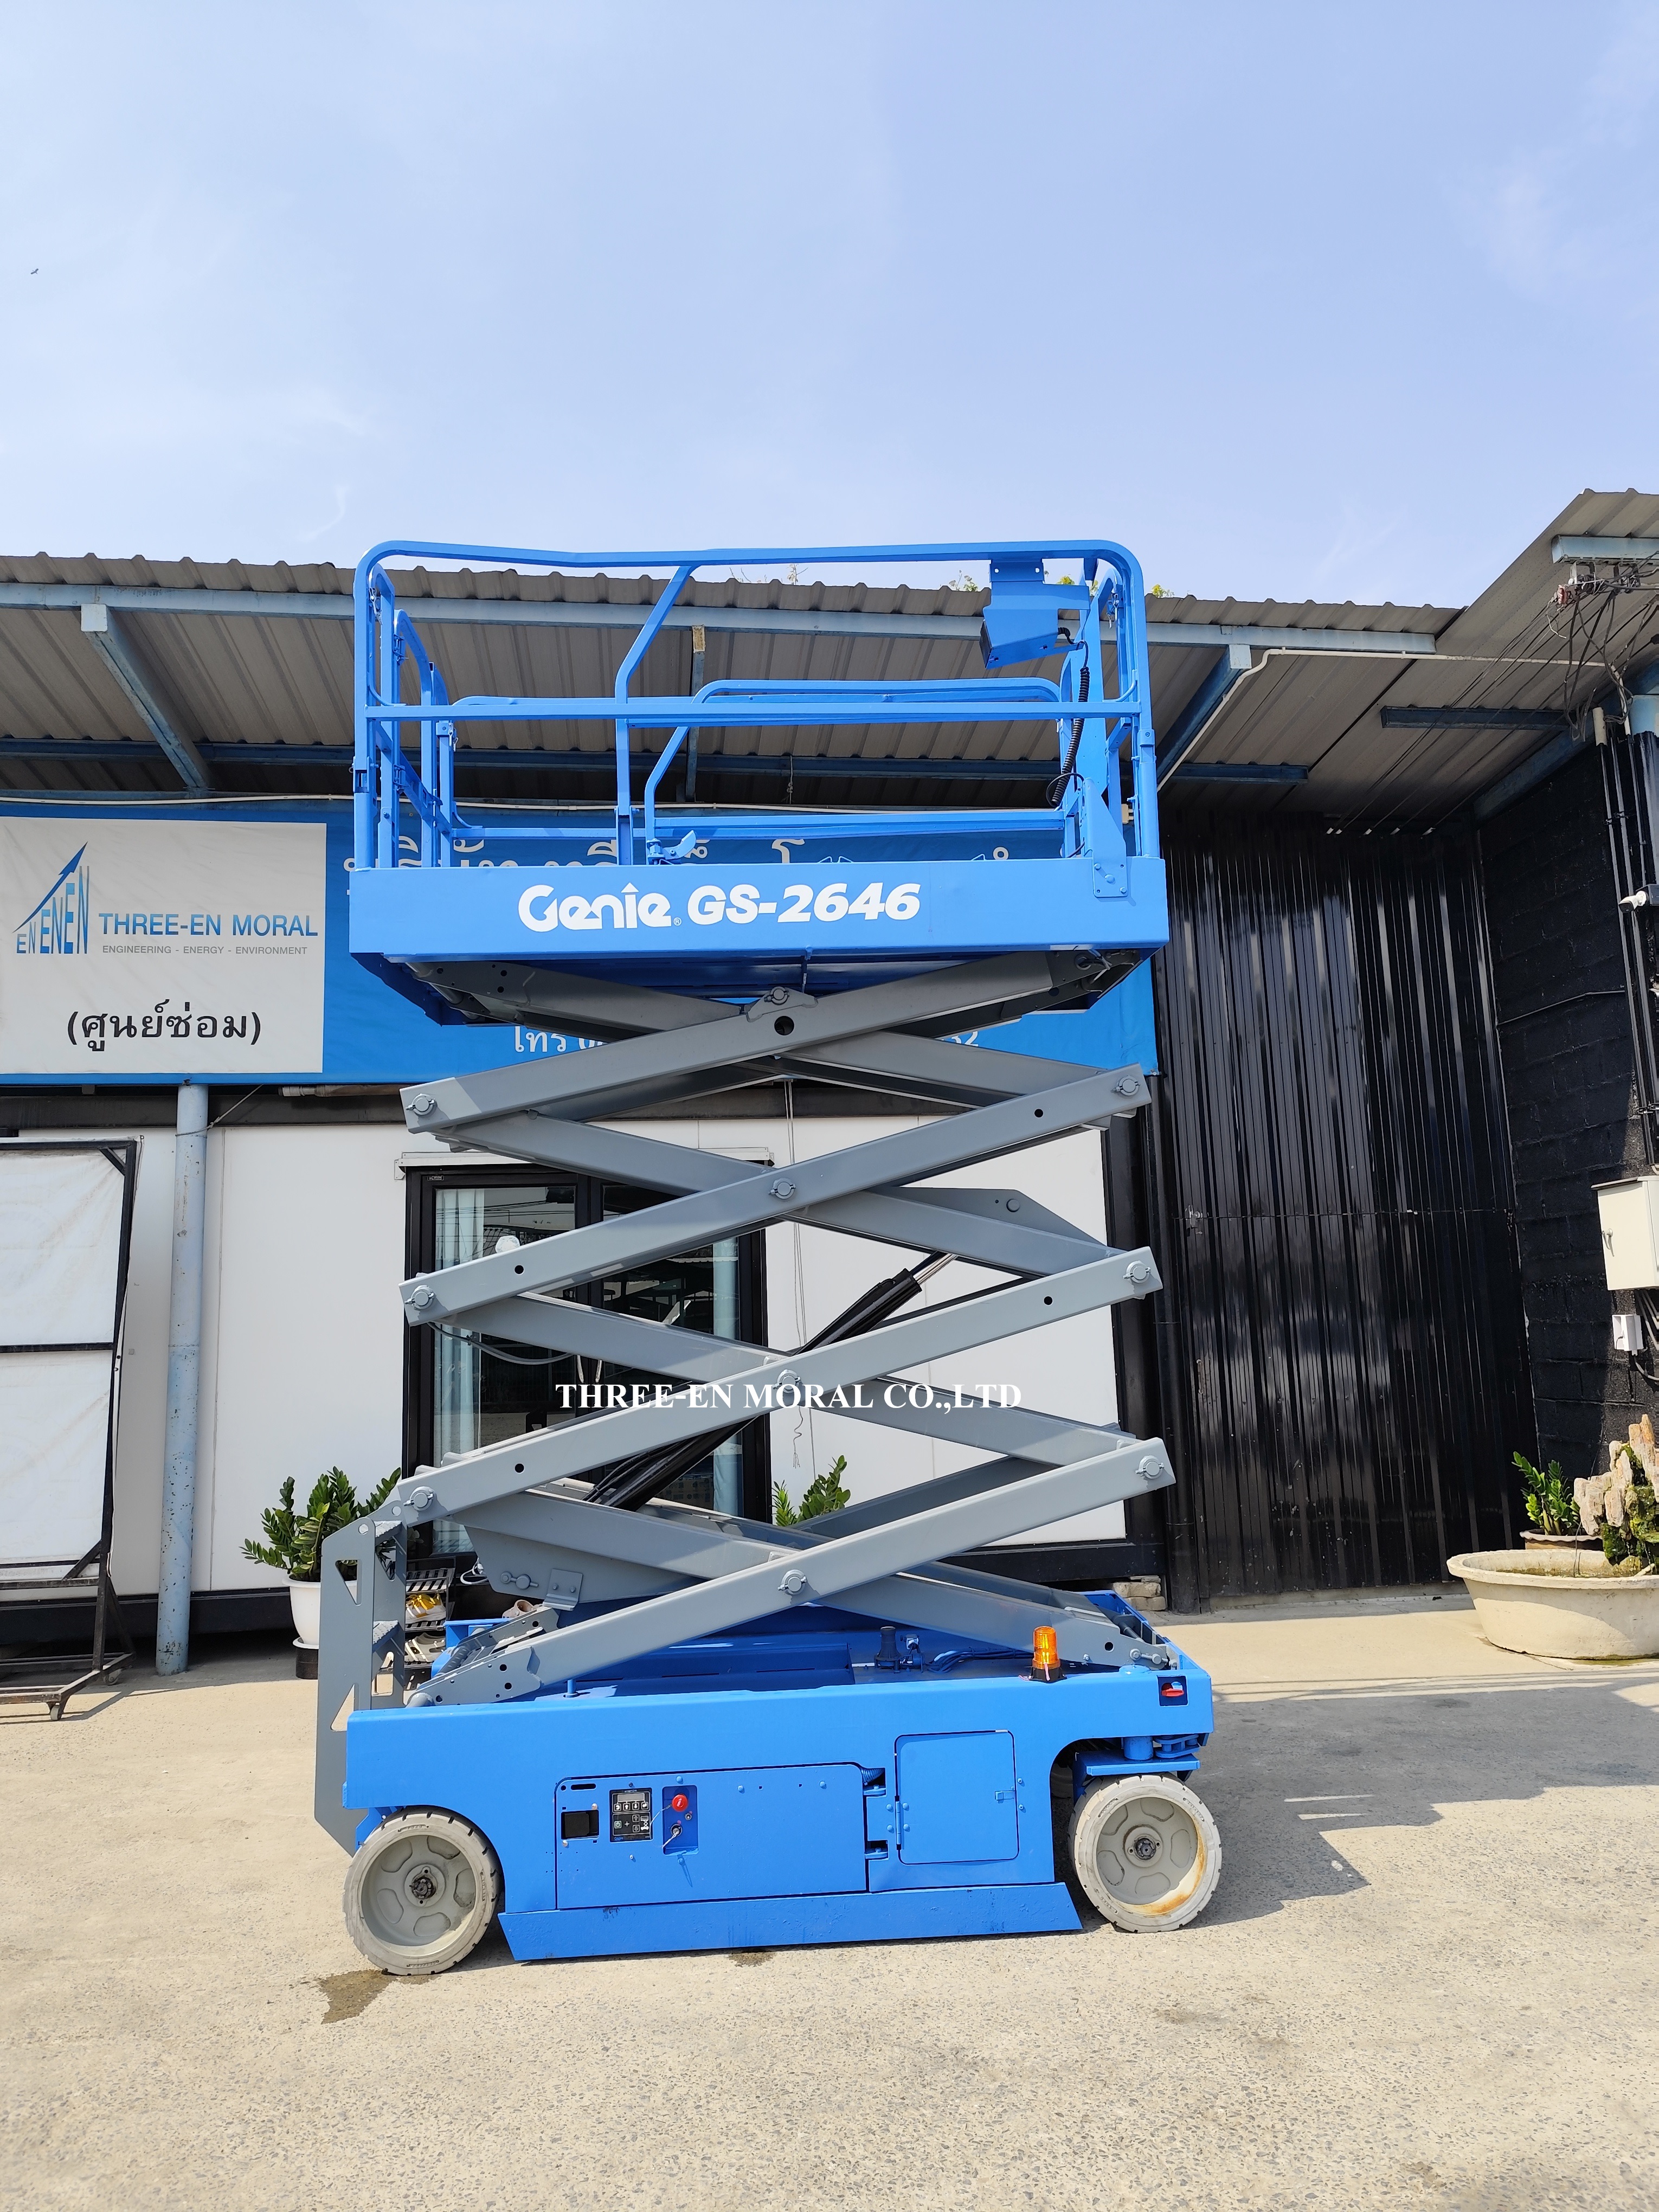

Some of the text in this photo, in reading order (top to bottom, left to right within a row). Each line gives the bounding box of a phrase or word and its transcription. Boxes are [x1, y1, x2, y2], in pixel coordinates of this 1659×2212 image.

[98, 913, 318, 936] THREE-EN MORAL
[518, 882, 922, 933] Genie GS-2646
[102, 945, 172, 954] ENGINEERING
[183, 946, 224, 954] ENERGY
[235, 946, 307, 955] ENVIRONMENT
[67, 999, 261, 1052] (ศูนย์ซ่อม)
